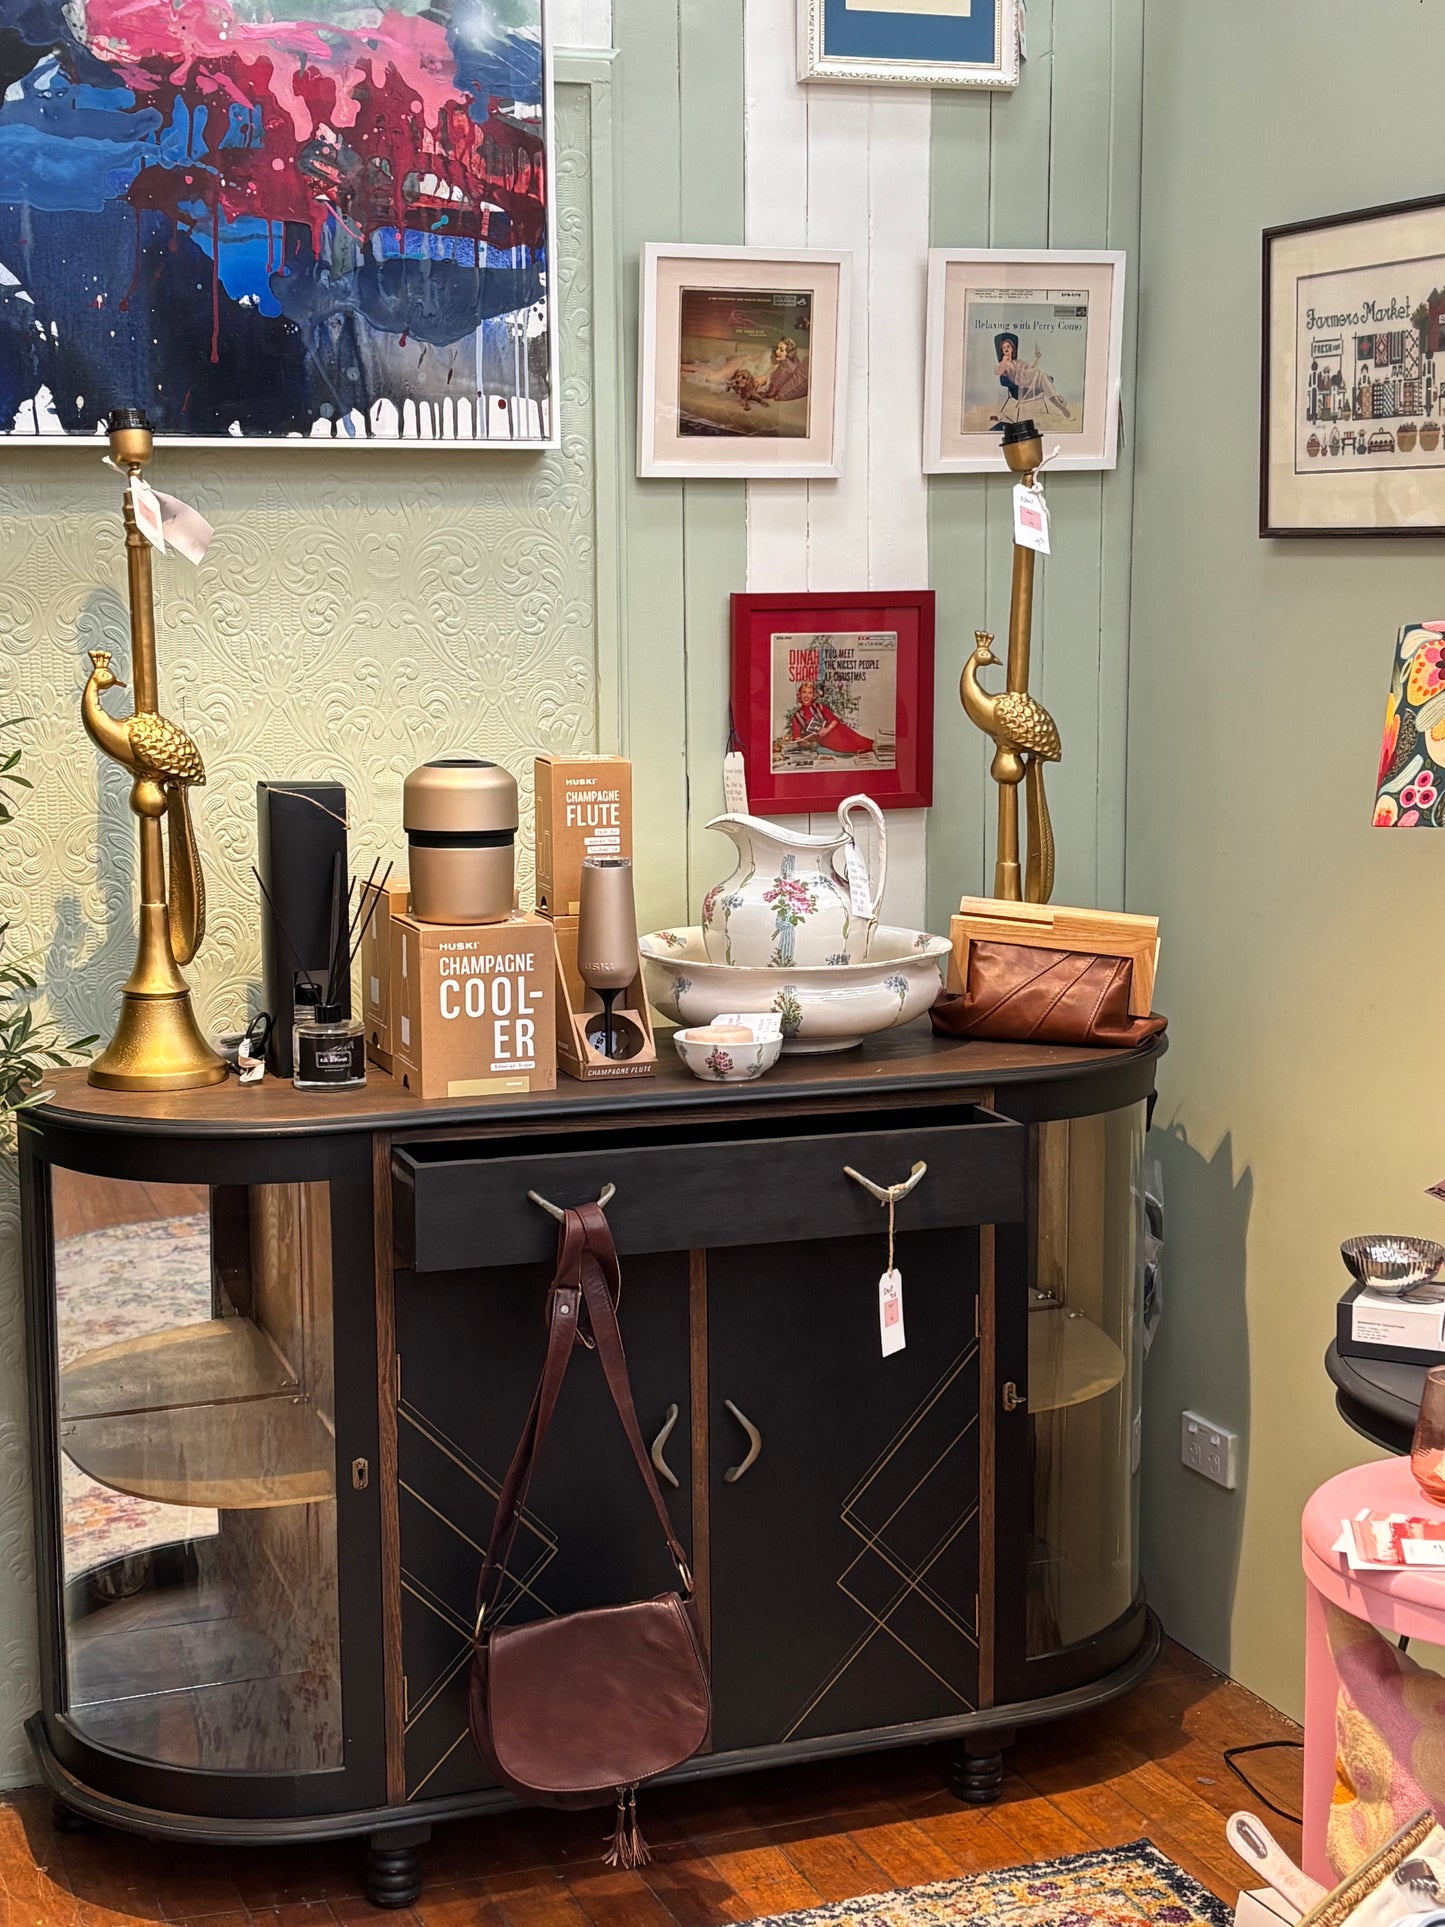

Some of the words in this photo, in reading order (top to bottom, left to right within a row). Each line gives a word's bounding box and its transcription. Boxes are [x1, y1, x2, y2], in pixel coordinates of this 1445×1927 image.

[1306, 308, 1359, 330] Farmers
[1360, 295, 1411, 324] Market
[974, 319, 1010, 332] Relaxing
[1012, 320, 1031, 330] with
[1033, 320, 1055, 333] Perry
[1058, 320, 1082, 330] Como
[789, 649, 820, 665] DINAH
[837, 648, 855, 658] MEET
[824, 660, 835, 670] THE
[837, 660, 857, 669] NICEST
[858, 660, 880, 669] PEOPLE
[833, 671, 867, 682] CHRISTMAS
[565, 778, 597, 786] HUSKI
[565, 790, 620, 803] CHAMPAGNE
[566, 803, 620, 827] FLUTE
[439, 941, 479, 951] HUSKI
[439, 953, 535, 976] CHAMPAGNE
[439, 976, 543, 1019] COOL-
[494, 1018, 535, 1059] ER
[587, 1067, 629, 1077] CHAMPAGNE
[631, 1065, 651, 1074] FLUTE
